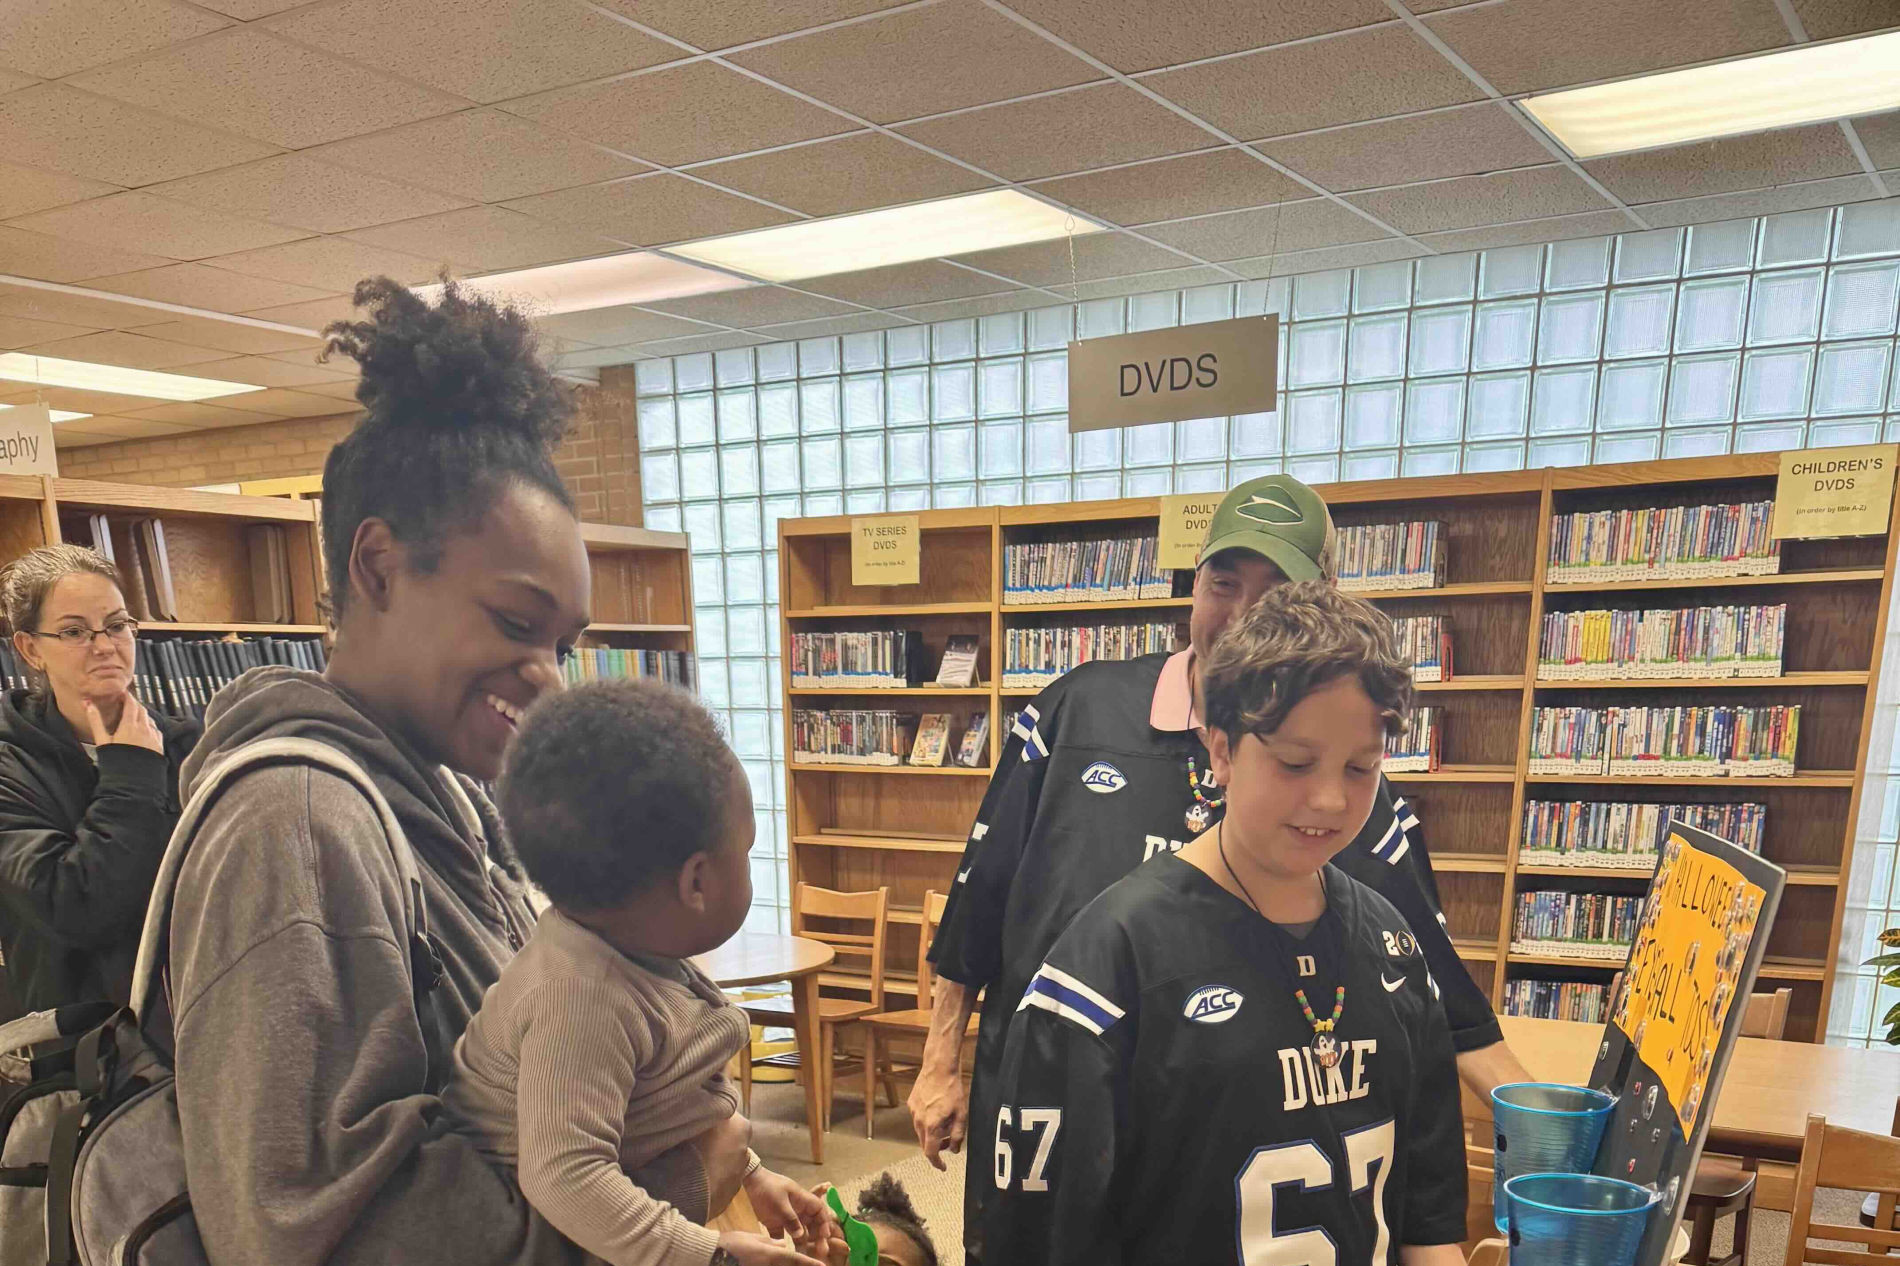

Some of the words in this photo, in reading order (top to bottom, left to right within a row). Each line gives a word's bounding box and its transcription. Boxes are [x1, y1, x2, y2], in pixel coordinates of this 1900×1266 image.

[1119, 352, 1219, 398] DVDS
[1791, 457, 1884, 475] CHILDREN'S
[1814, 478, 1855, 492] DVDS
[863, 527, 874, 536] TV
[876, 526, 907, 536] SERIES
[1185, 519, 1212, 530] DVD
[872, 540, 897, 550] DVDS
[1084, 769, 1122, 788] ACC
[1296, 955, 1317, 977] D
[1191, 989, 1237, 1020] ACC
[1277, 1039, 1378, 1111] DUKE
[994, 1103, 1063, 1192] 67
